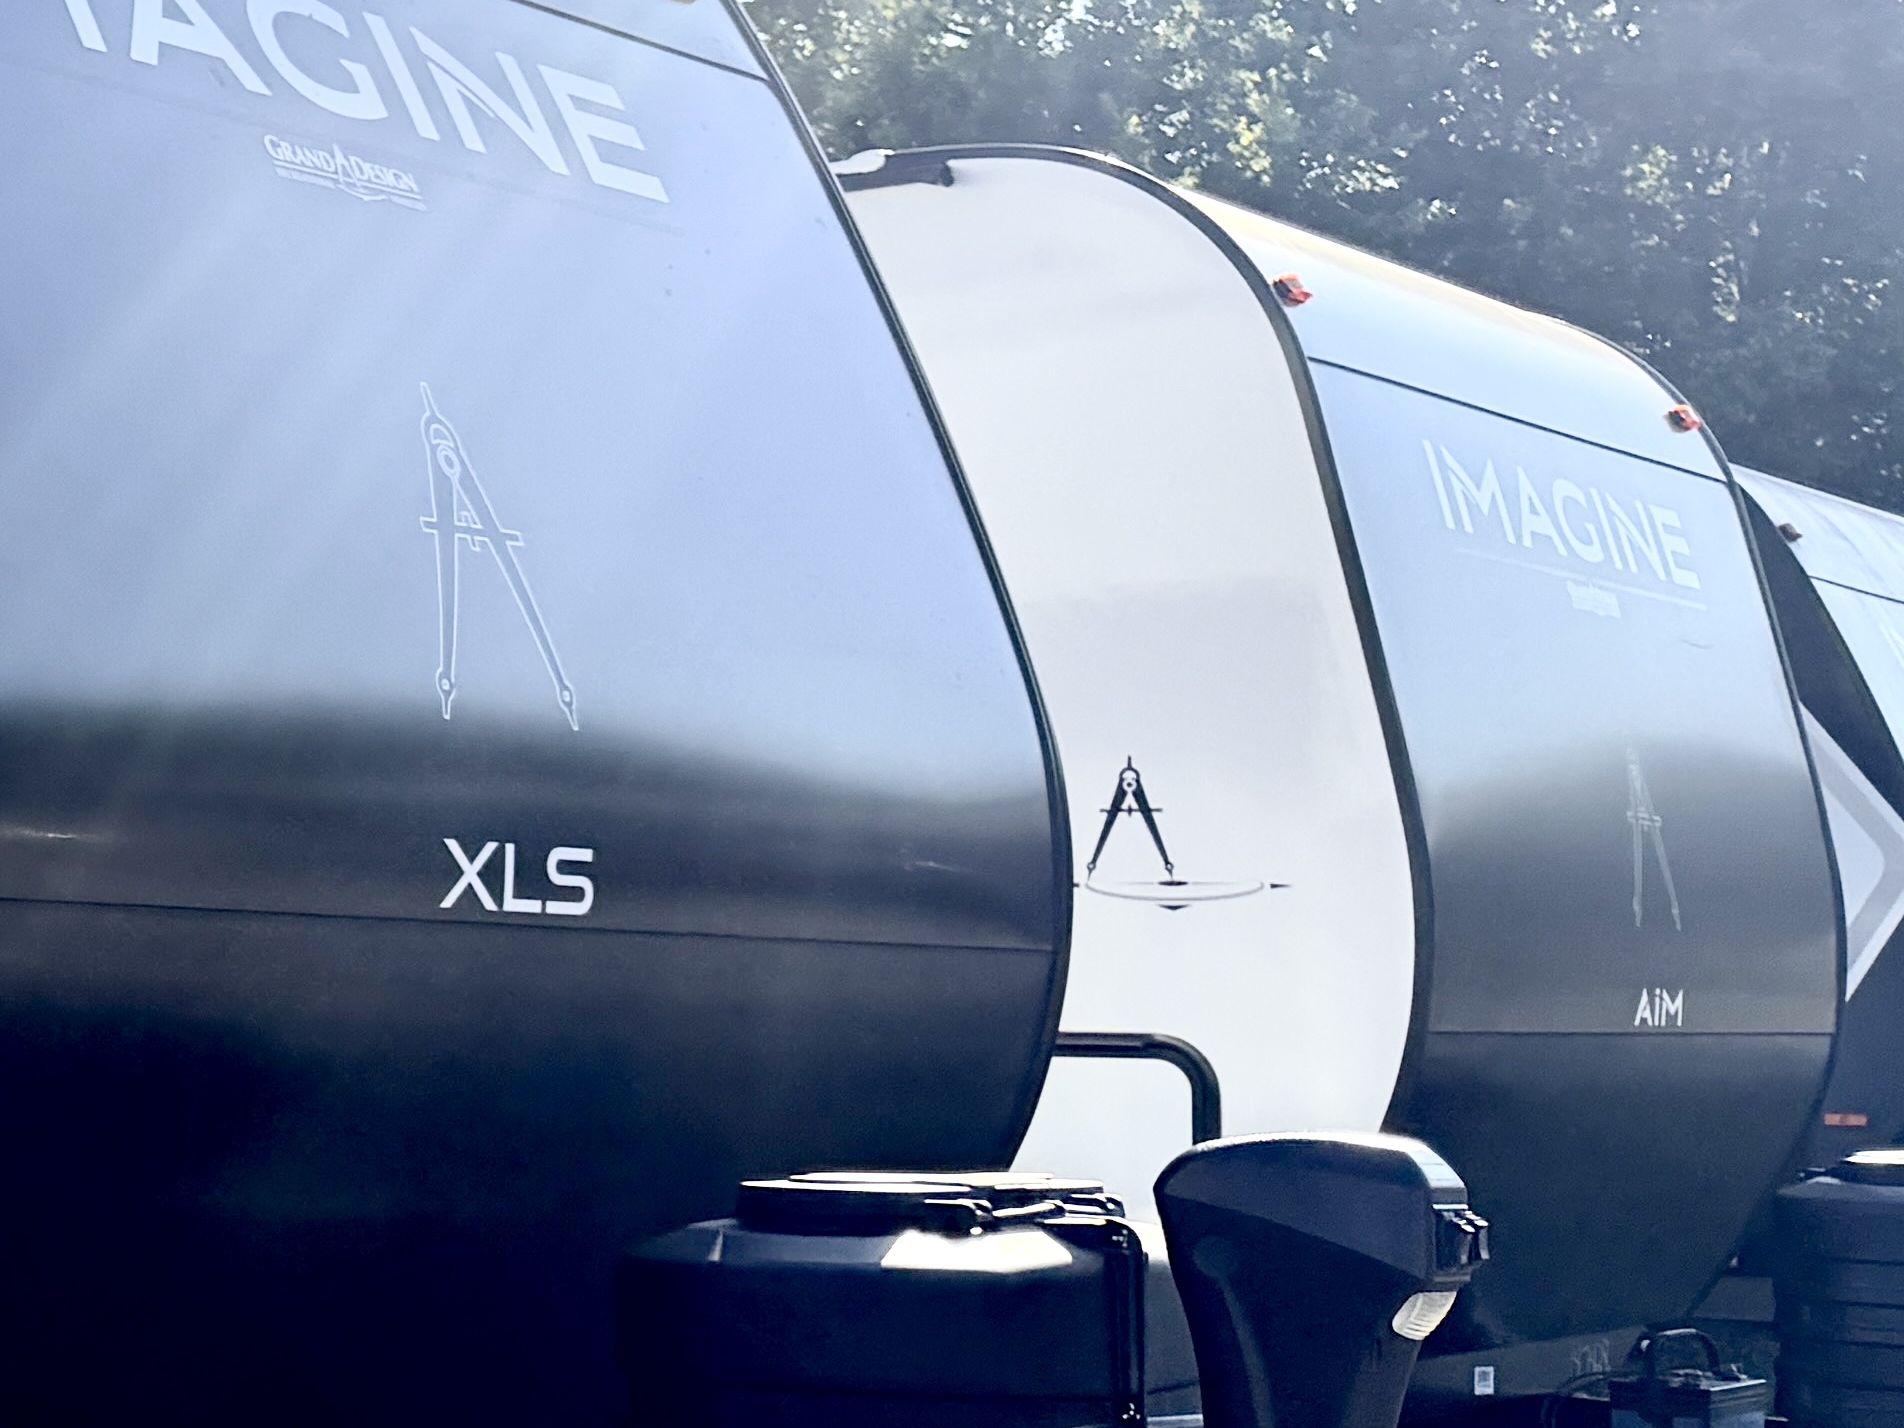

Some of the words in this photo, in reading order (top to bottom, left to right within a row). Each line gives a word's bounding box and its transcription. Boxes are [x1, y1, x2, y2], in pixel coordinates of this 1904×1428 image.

[263, 134, 336, 172] GRAND
[348, 155, 419, 193] DESIGN
[1422, 439, 1701, 591] IMAGINE
[439, 838, 594, 916] XLS
